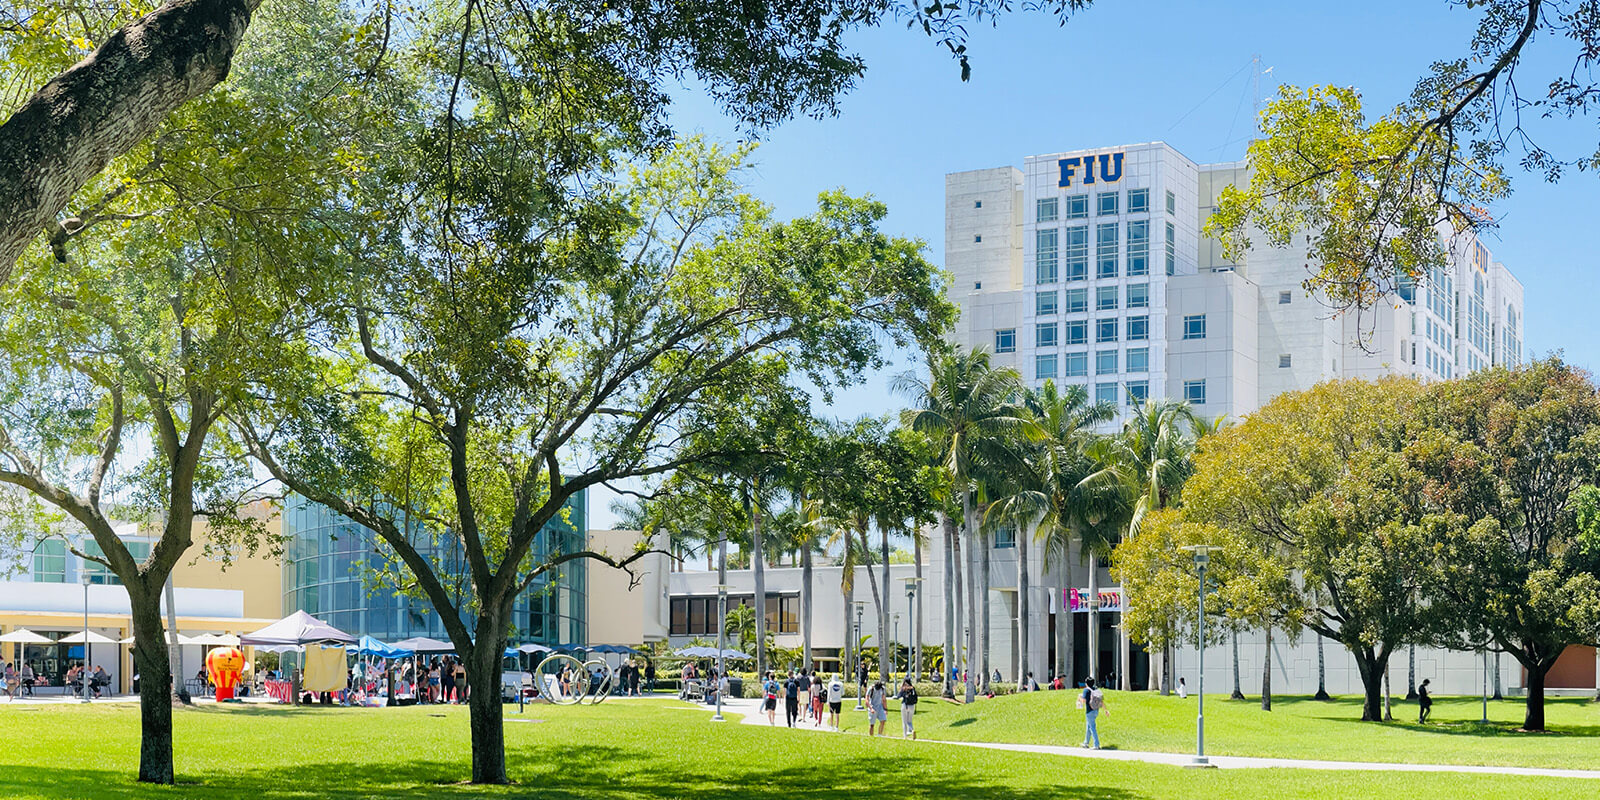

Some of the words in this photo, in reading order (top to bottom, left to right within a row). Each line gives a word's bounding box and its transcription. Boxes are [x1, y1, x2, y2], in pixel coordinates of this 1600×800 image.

[1058, 152, 1125, 188] FIU
[205, 542, 242, 552] raam
[206, 553, 239, 562] Cener
